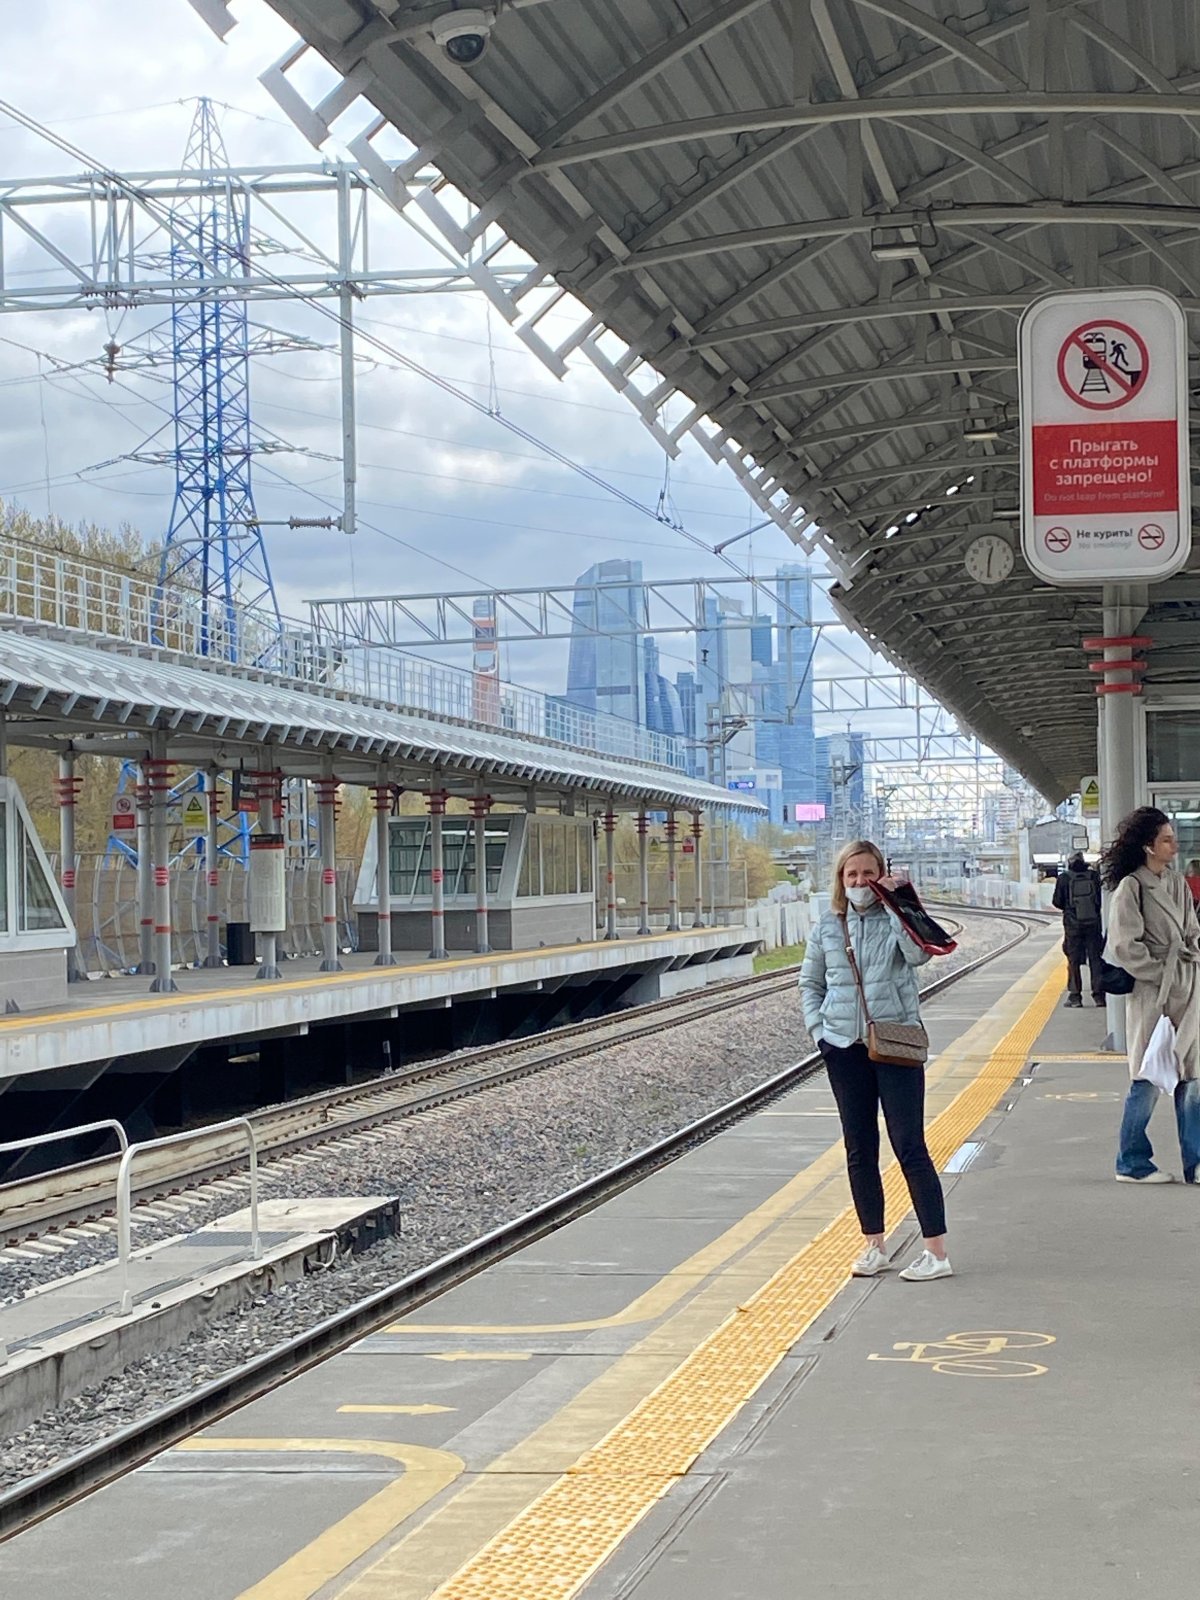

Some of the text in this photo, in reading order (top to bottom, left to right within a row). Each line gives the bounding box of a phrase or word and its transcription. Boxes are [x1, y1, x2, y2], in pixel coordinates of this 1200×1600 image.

[1070, 438, 1138, 455] Прыгать
[1049, 455, 1158, 470] с платформы
[1055, 469, 1152, 487] запрещено!
[1098, 491, 1120, 500] from
[1076, 528, 1133, 540] Не курить!
